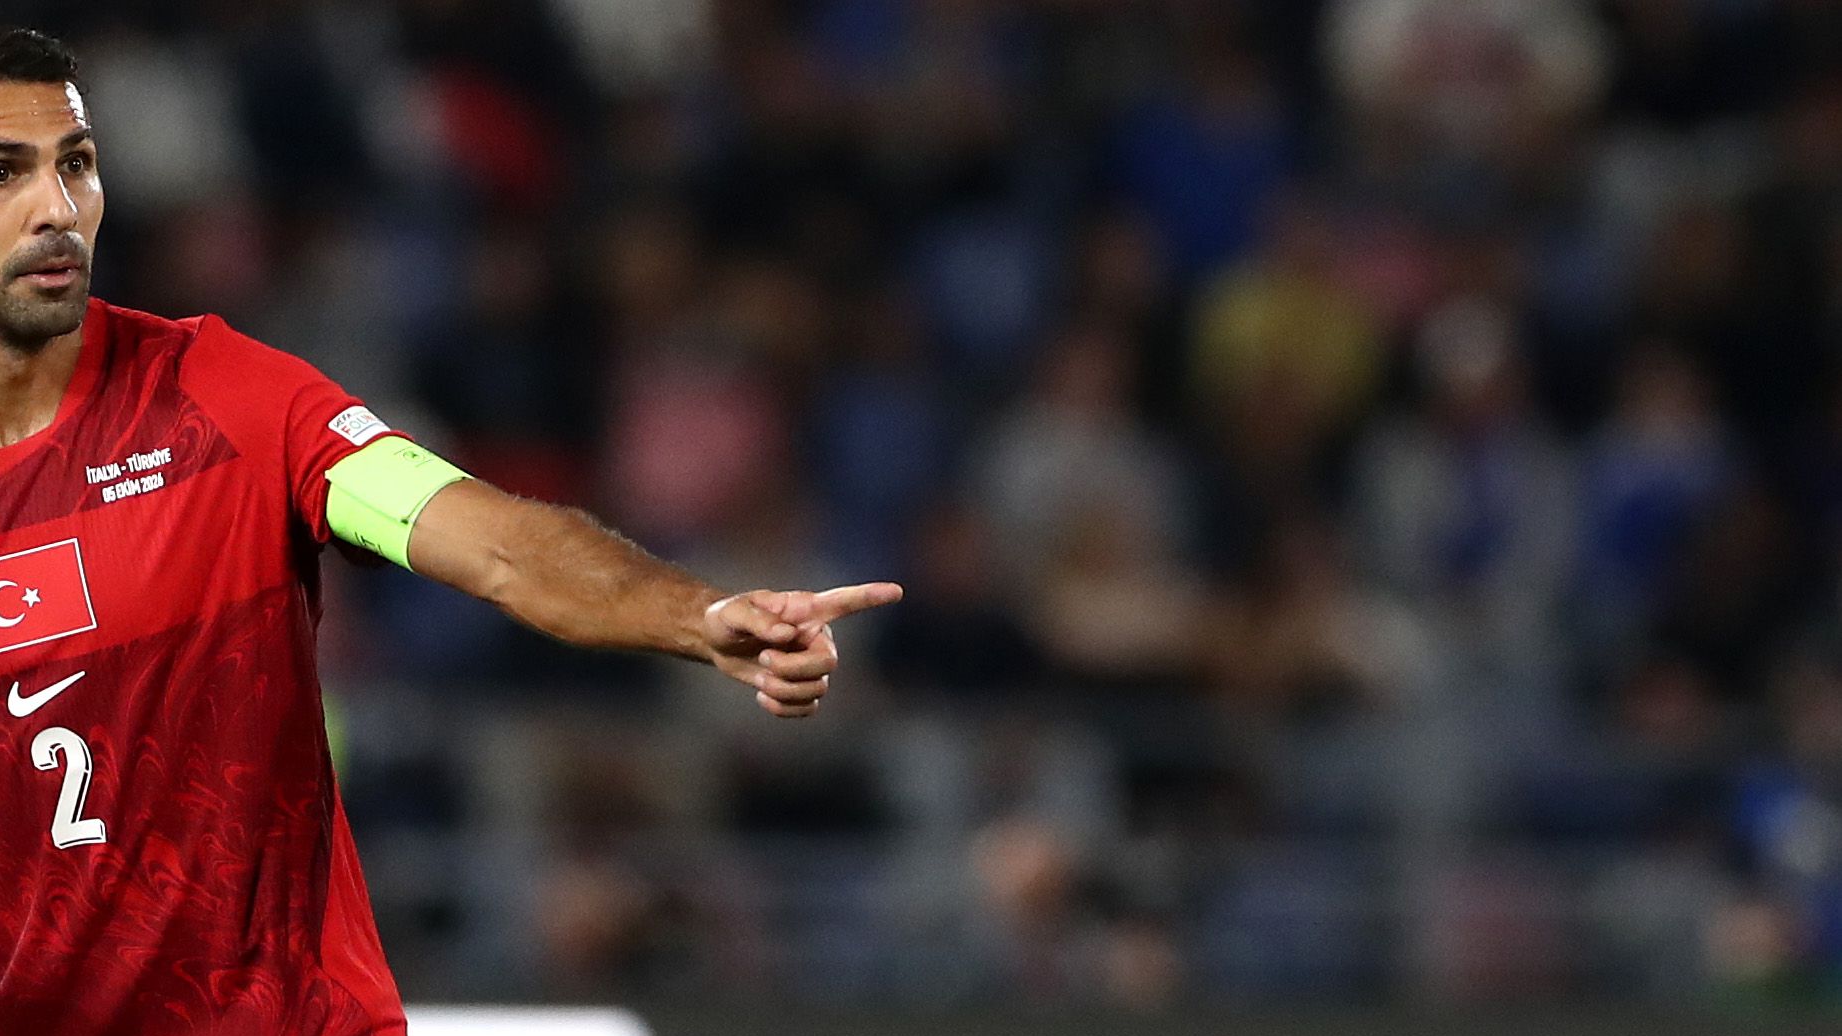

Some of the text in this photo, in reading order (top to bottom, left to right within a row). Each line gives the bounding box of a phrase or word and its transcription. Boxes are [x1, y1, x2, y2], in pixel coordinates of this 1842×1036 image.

[85, 462, 122, 484] İTALYA
[125, 447, 172, 473] TÜRKİYE
[102, 485, 117, 503] 05
[115, 477, 142, 499] EKİM
[30, 726, 107, 850] 2
